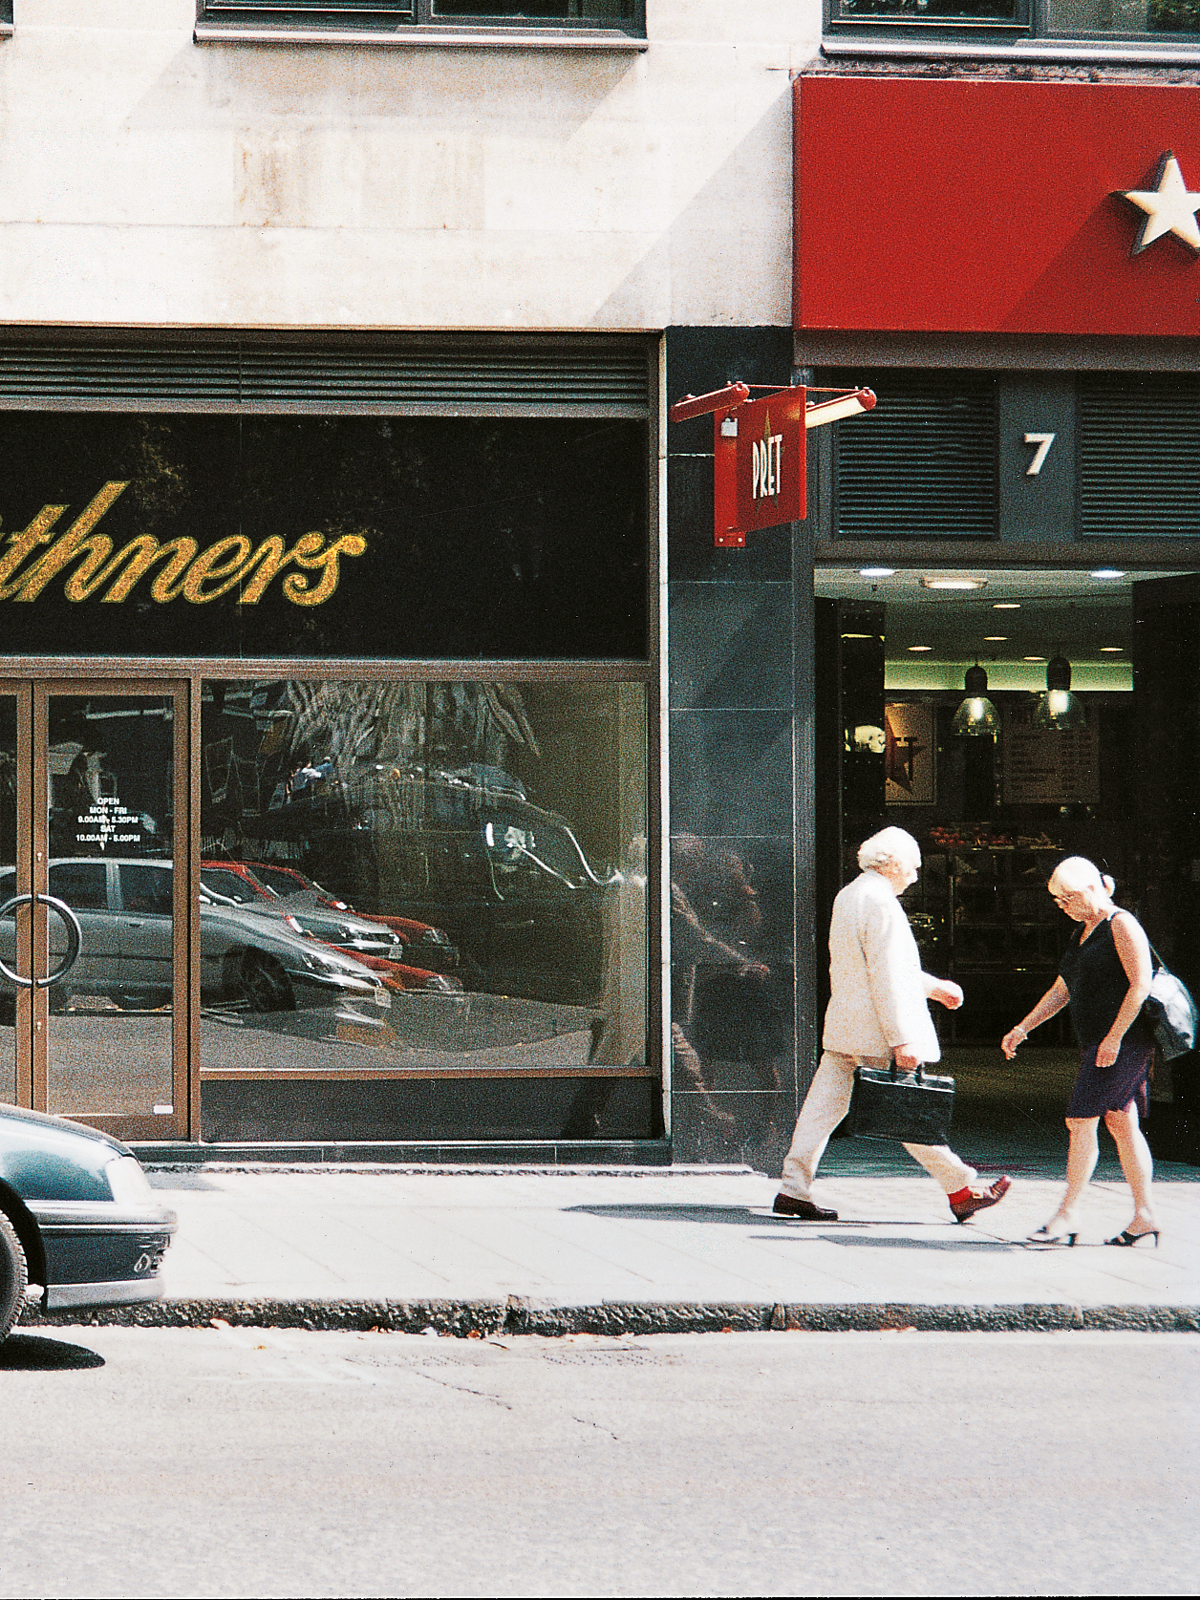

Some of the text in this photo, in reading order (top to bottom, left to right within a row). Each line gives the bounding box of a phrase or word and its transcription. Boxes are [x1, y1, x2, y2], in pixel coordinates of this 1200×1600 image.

[751, 433, 784, 500] PRET
[1023, 432, 1057, 477] 7
[89, 806, 109, 814] MON
[113, 806, 128, 814] FRI
[97, 797, 119, 805] OPEN
